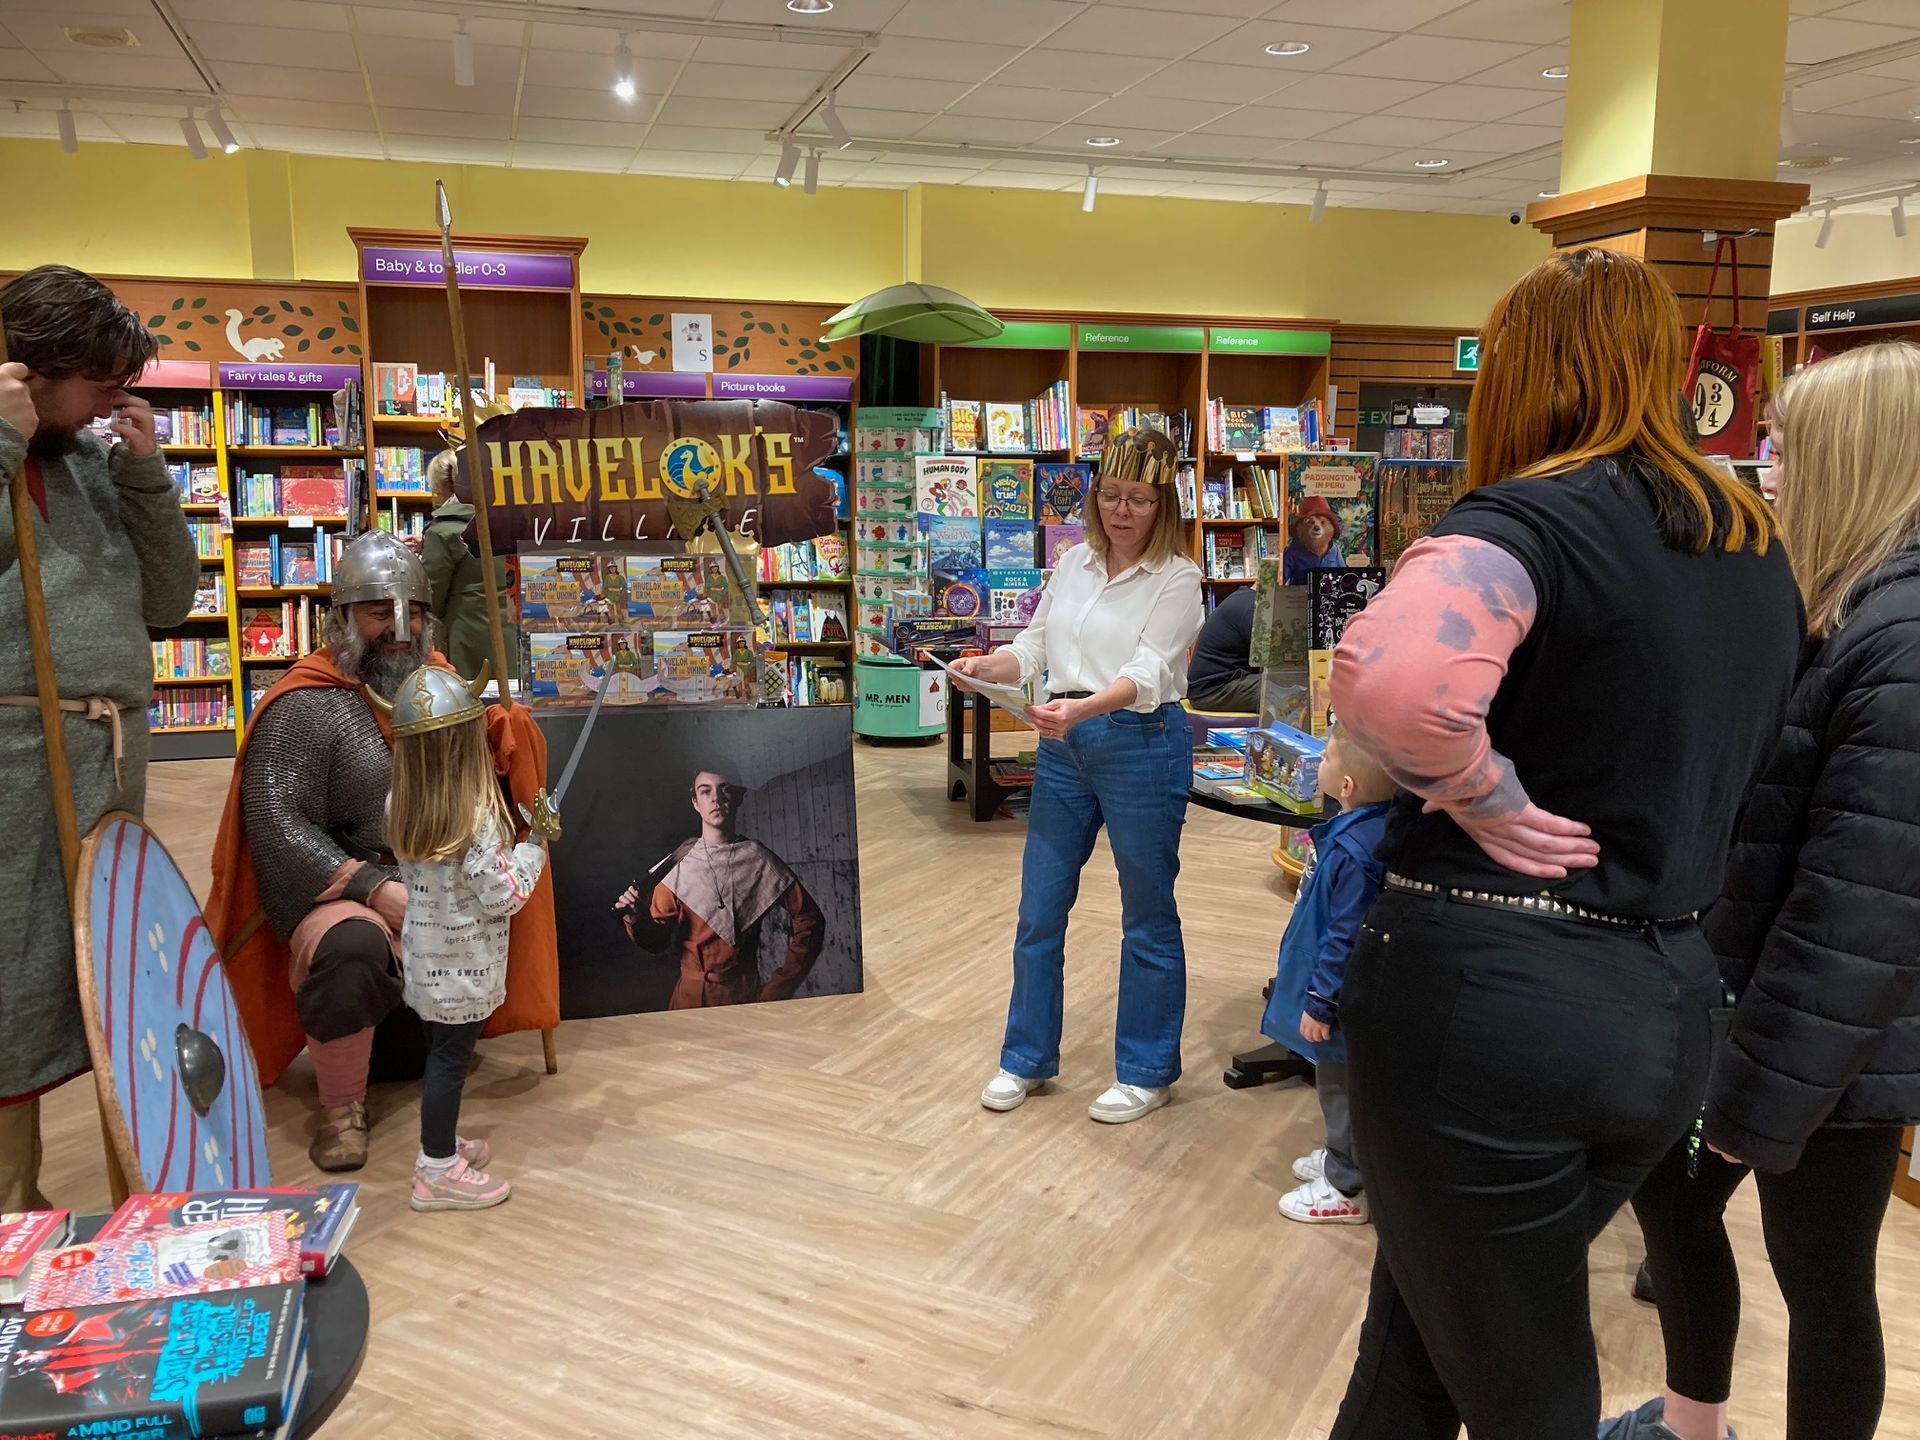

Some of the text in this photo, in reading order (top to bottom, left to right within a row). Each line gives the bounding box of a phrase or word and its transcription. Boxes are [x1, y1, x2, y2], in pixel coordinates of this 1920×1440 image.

[375, 258, 506, 276] Baby & todler 0-3
[1812, 308, 1856, 323] Self Help
[1085, 332, 1130, 345] Reference
[1216, 335, 1259, 347] Reference
[698, 349, 708, 362] S
[228, 370, 323, 384] Fairy tales & gifts
[605, 378, 635, 390] bks
[720, 381, 786, 393] Picture books
[1694, 382, 1706, 421] 9
[486, 426, 797, 507] HAVELOK'S
[923, 465, 970, 476] HUMAN BODY
[993, 475, 1020, 488] weird
[1305, 473, 1356, 482] PADDINGTON
[1325, 481, 1345, 489] PERU
[995, 490, 1017, 499] true!
[1004, 502, 1027, 514] 2025
[534, 508, 759, 547] VILLE
[819, 537, 846, 549] Banana
[824, 546, 842, 555] Hunt
[527, 582, 558, 592] HAVELOK
[556, 591, 577, 600] VIKING
[566, 669, 580, 678] VIKI
[865, 692, 911, 704] MR. MEN
[936, 699, 943, 711] G
[416, 899, 441, 910] NICE
[426, 967, 491, 978] 100% SWEET
[181, 1198, 223, 1226] ER
[125, 1267, 154, 1290] Hot
[67, 1426, 78, 1437] A
[79, 1418, 131, 1437] MIND
[136, 1413, 173, 1428] FULL
